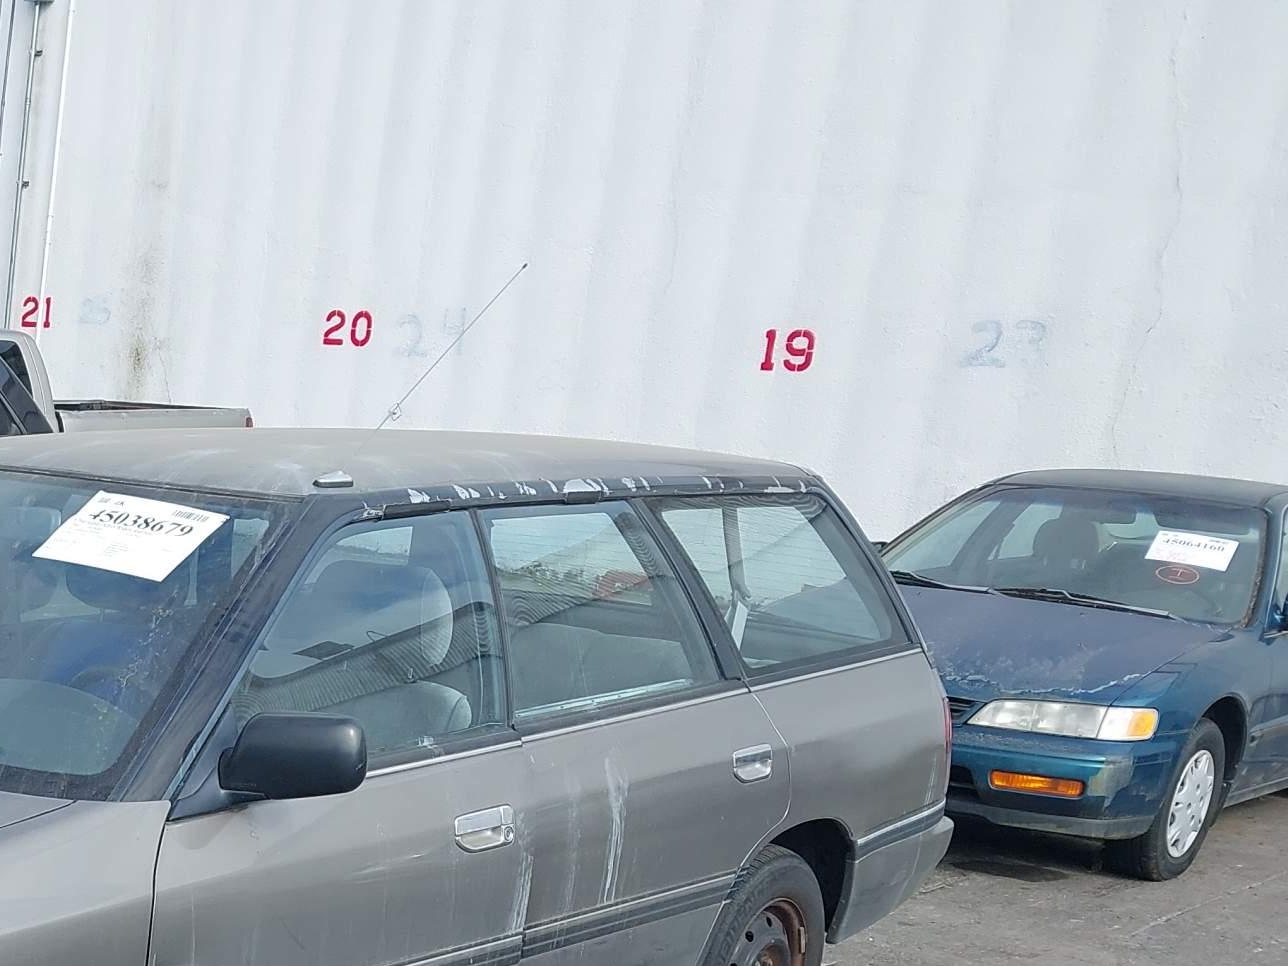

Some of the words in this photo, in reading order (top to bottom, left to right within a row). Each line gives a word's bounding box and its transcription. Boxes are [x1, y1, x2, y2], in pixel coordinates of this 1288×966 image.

[21, 296, 51, 328] 21
[323, 310, 372, 347] 20
[760, 328, 815, 372] 19
[89, 509, 194, 537] 45038679
